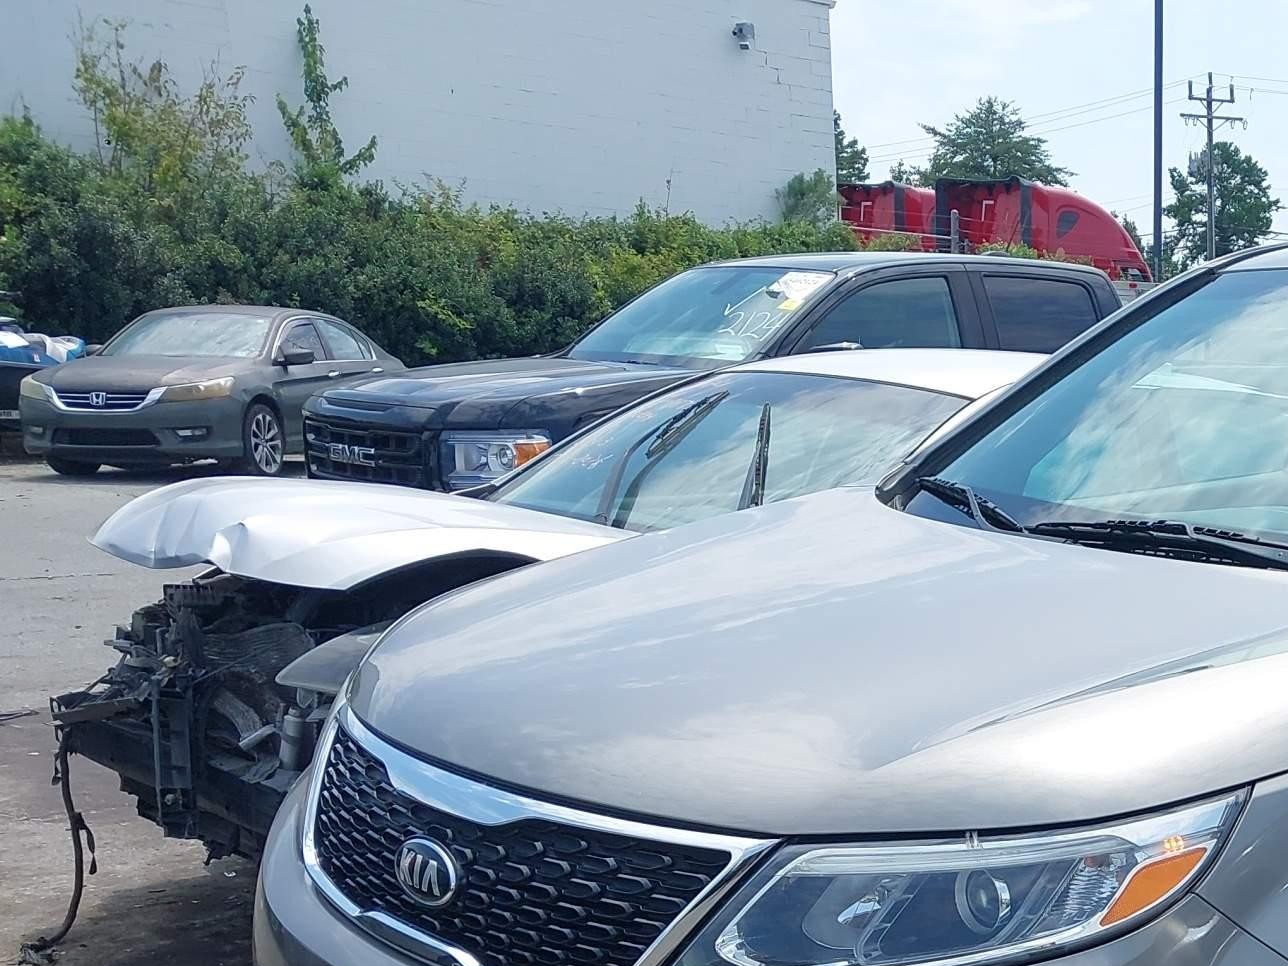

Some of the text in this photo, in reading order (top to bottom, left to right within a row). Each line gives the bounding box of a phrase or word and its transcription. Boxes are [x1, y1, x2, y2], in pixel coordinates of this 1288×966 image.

[718, 311, 792, 342] 2124
[328, 442, 377, 468] GMC
[400, 847, 441, 897] KIA
